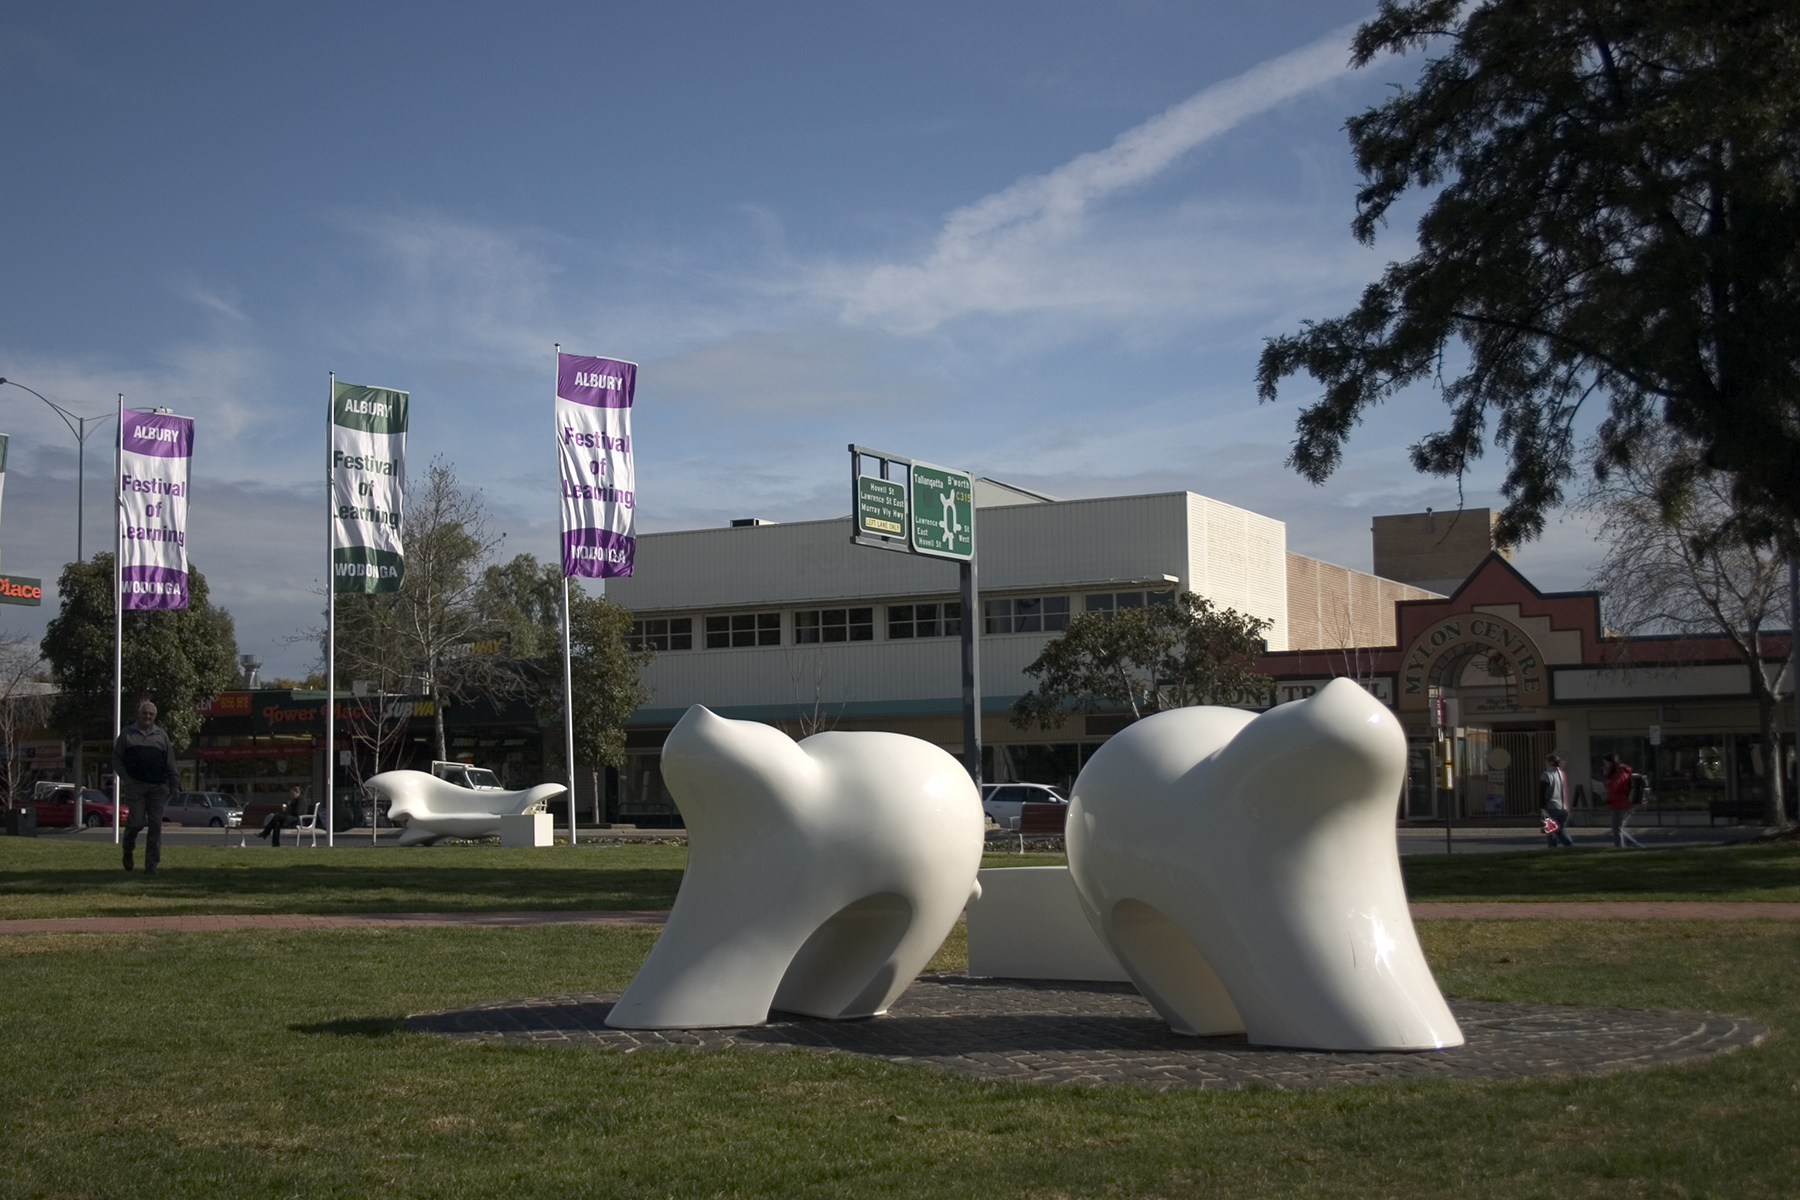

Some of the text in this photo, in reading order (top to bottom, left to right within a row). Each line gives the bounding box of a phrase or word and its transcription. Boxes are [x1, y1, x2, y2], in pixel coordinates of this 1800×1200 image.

[574, 371, 623, 391] ALBURY
[345, 398, 393, 418] ALBURY
[133, 425, 180, 443] ALBURY
[564, 427, 630, 453] Festival
[334, 450, 398, 477] Festival
[589, 457, 607, 476] of
[122, 474, 185, 498] Festival
[358, 480, 375, 497] of
[870, 483, 895, 496] Hovell St
[914, 473, 944, 489] Tallangatta
[947, 475, 970, 490] B'worth
[564, 479, 633, 509] Learning
[860, 491, 905, 508] Lawrence St East
[145, 501, 162, 517] of
[334, 504, 399, 530] earning
[861, 503, 904, 521] Murray Vly Hwy
[866, 518, 900, 532] LEFT LANE ONLY
[915, 515, 938, 527] Lawrence
[964, 525, 970, 533] St
[121, 525, 185, 547] earning
[917, 527, 928, 536] East
[958, 534, 970, 543] West
[919, 537, 942, 549] Hovell St
[334, 562, 398, 579] WODONGA
[122, 580, 181, 596] WODONGA
[1405, 620, 1541, 696] MYLON CENTRE
[263, 704, 318, 726] Tower
[383, 701, 449, 719] SUBWA
